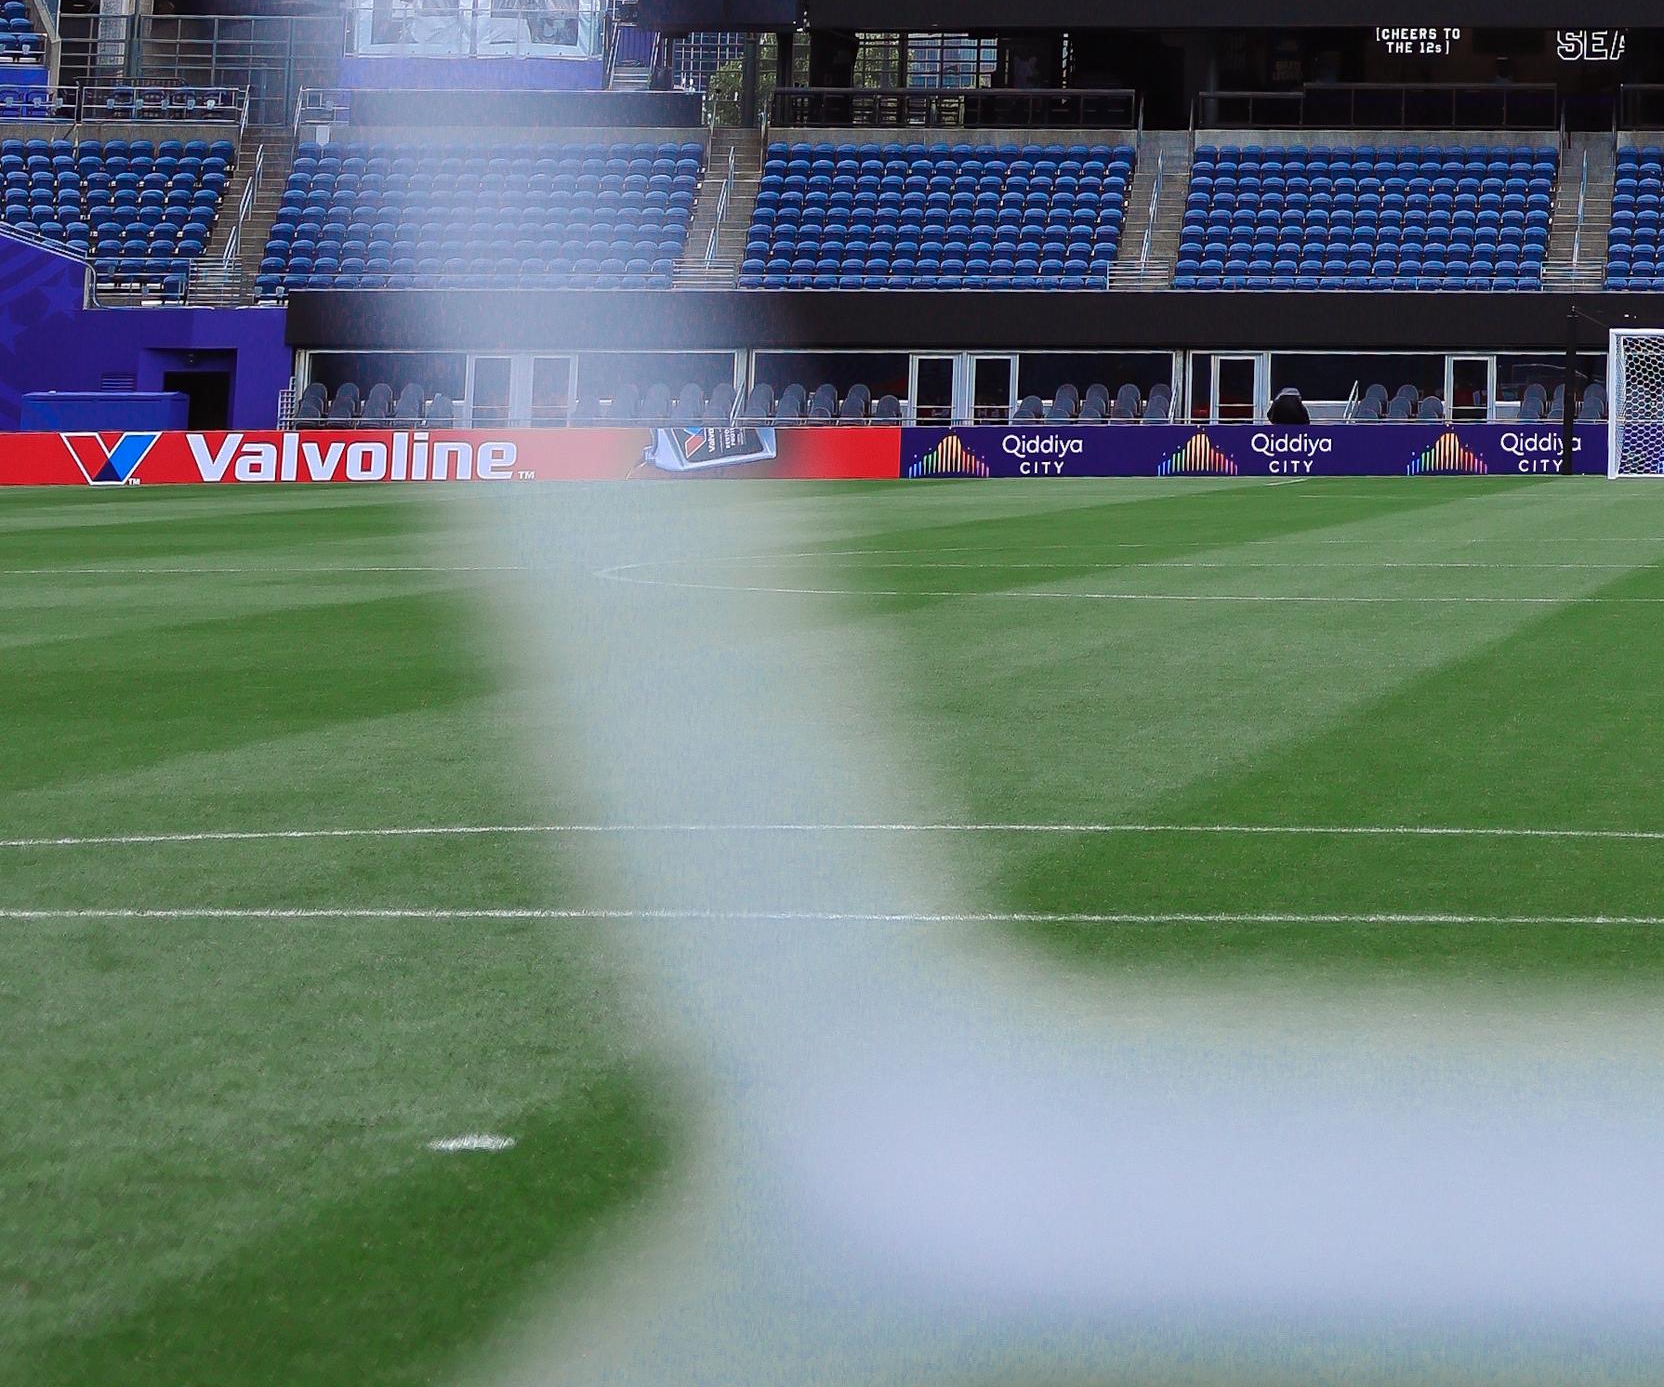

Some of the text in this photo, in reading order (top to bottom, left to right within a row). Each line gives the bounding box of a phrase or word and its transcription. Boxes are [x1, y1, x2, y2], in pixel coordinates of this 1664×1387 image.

[1443, 28, 1461, 40] TO
[1386, 41, 1413, 54] THE
[1002, 434, 1083, 458] Qiddiya
[1251, 433, 1332, 457] Qiddiya
[185, 431, 517, 481] Valvoline
[1020, 461, 1064, 475] CITY
[1268, 460, 1313, 473] CITY
[1518, 459, 1563, 472] CITY
